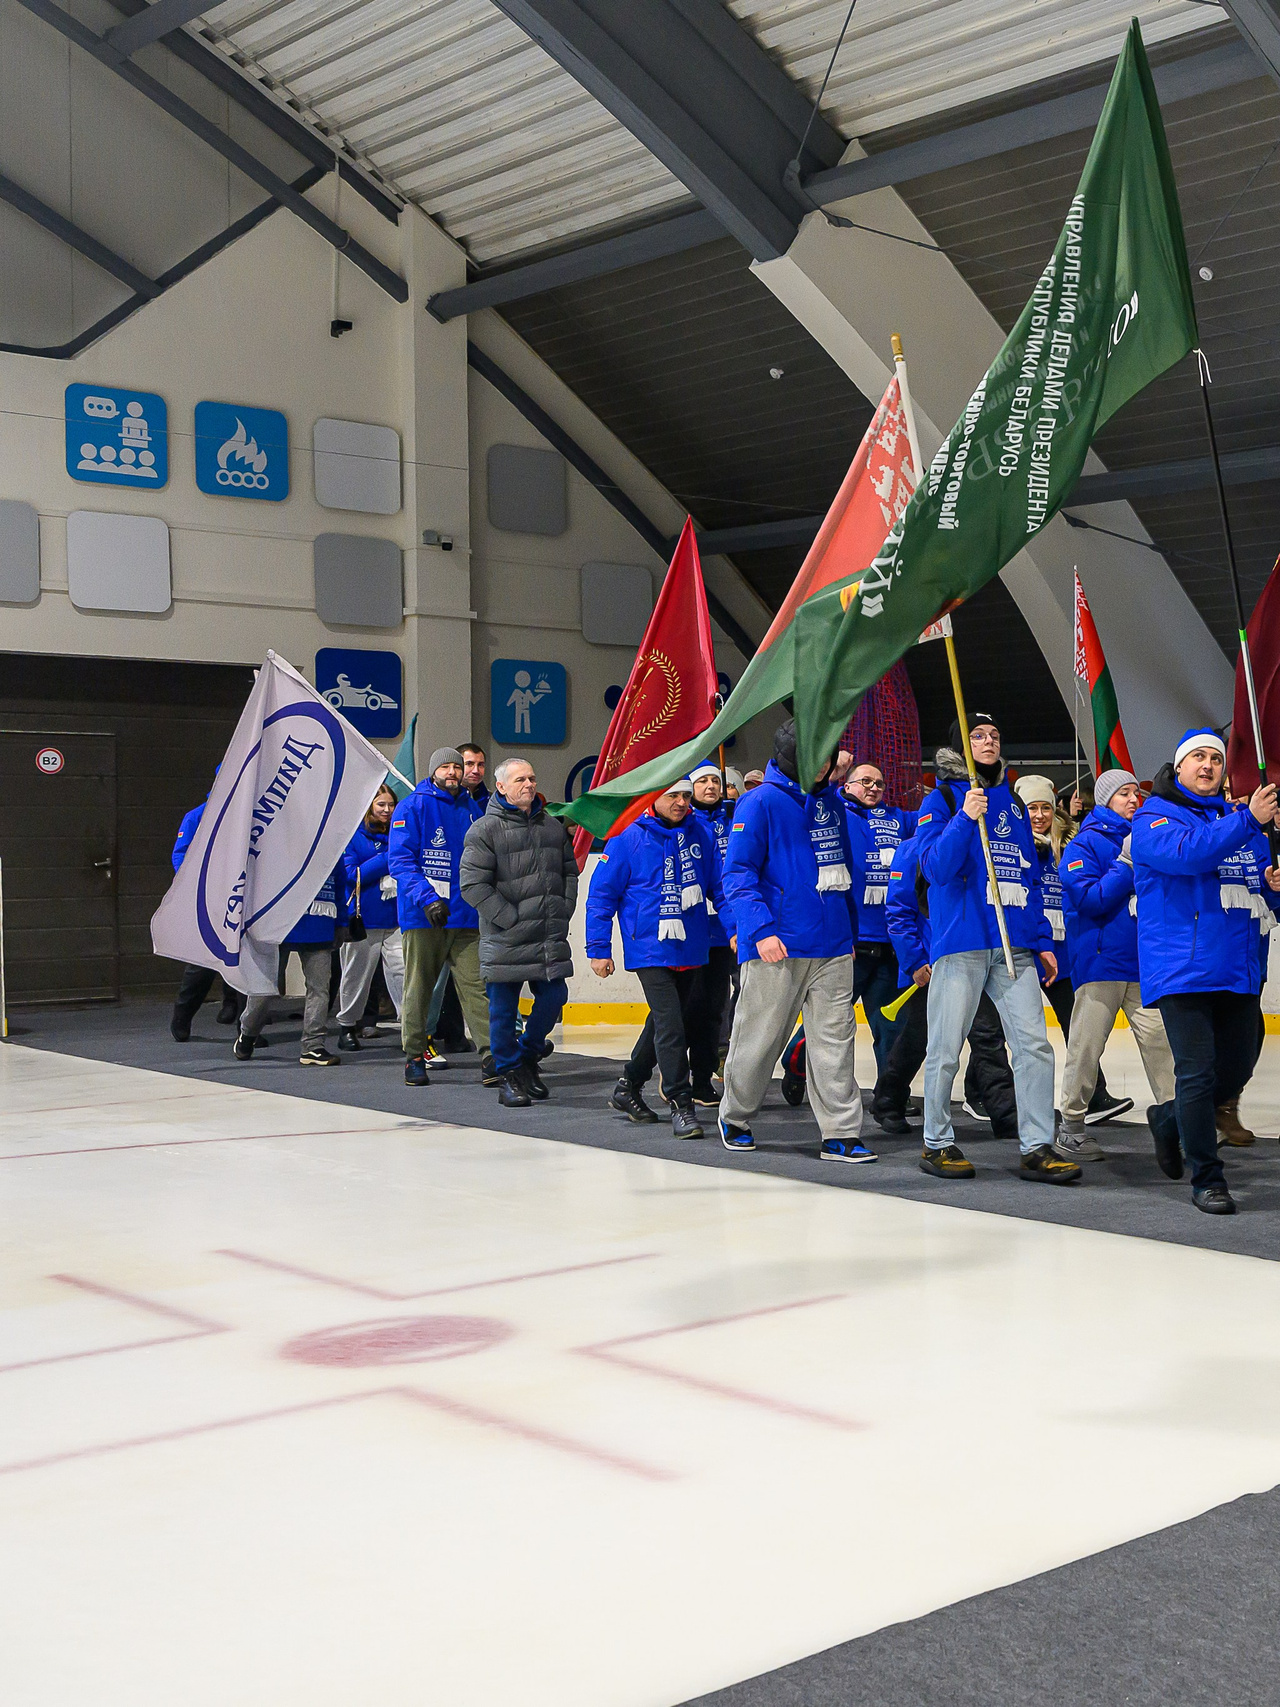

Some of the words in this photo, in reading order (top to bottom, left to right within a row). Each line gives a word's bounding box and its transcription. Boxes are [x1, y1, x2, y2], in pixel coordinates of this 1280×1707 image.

[1056, 193, 1085, 324] УПРАВЛЕНИЯ
[1041, 329, 1073, 410] ДЕЛАМИ
[998, 386, 1033, 477] БЕЛАРУСЬ
[1026, 417, 1057, 534] ПРЕЗИДЕНТА
